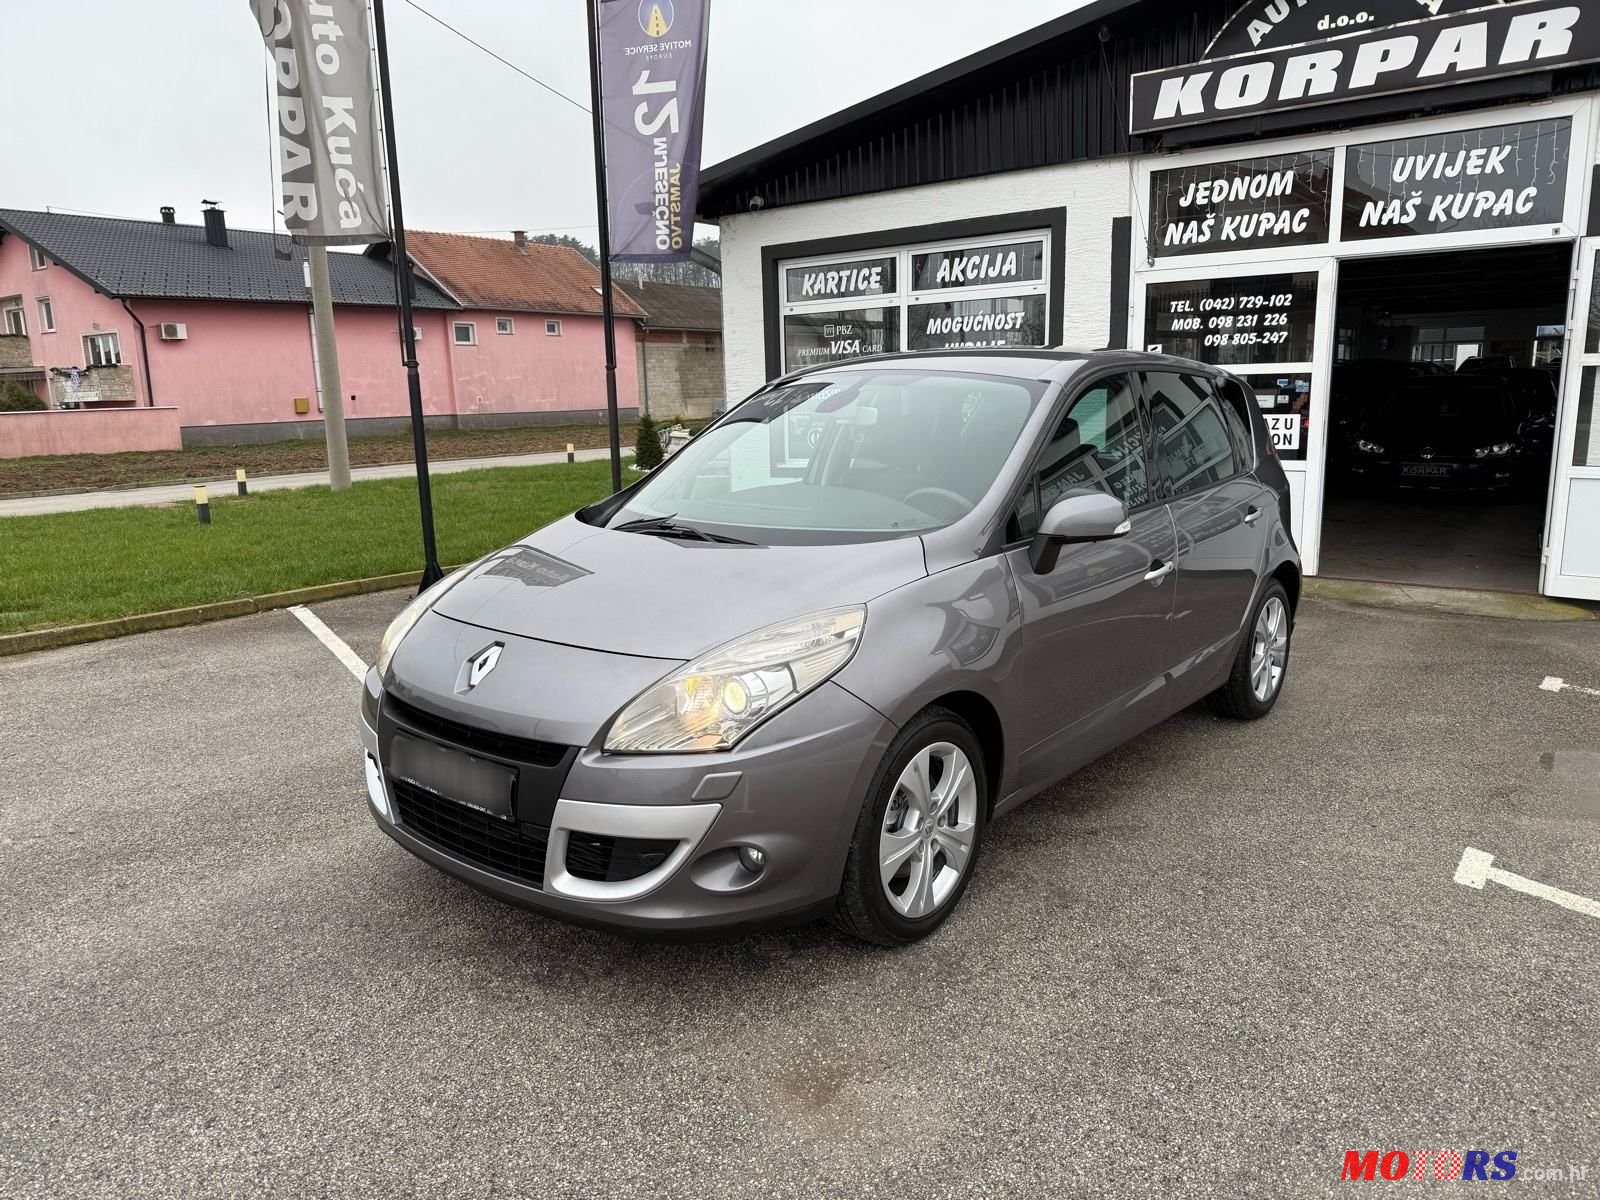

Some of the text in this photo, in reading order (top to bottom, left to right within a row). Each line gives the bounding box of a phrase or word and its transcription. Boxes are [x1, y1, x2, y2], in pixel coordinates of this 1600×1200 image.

[1317, 11, 1375, 31] d.o.o.
[1153, 6, 1581, 120] KORPAR
[321, 95, 365, 229] Kuća
[1392, 145, 1513, 183] UVIJEK
[1179, 170, 1295, 207] JEDNOM
[1359, 186, 1538, 227] NAŠ KUPAC
[1164, 208, 1310, 246] NAŠ KUPAC
[801, 266, 882, 297] KARTICE
[936, 251, 1017, 283] AKCIJA
[1170, 294, 1293, 313] TEL. (042) 729-102
[836, 325, 853, 335] PBZ
[926, 310, 1025, 335] MOGUĆNOST
[1171, 313, 1288, 331] MOB. 098 231 226
[797, 339, 883, 357] PREMIUM VISA CARD
[1204, 331, 1288, 346] 098 805-247
